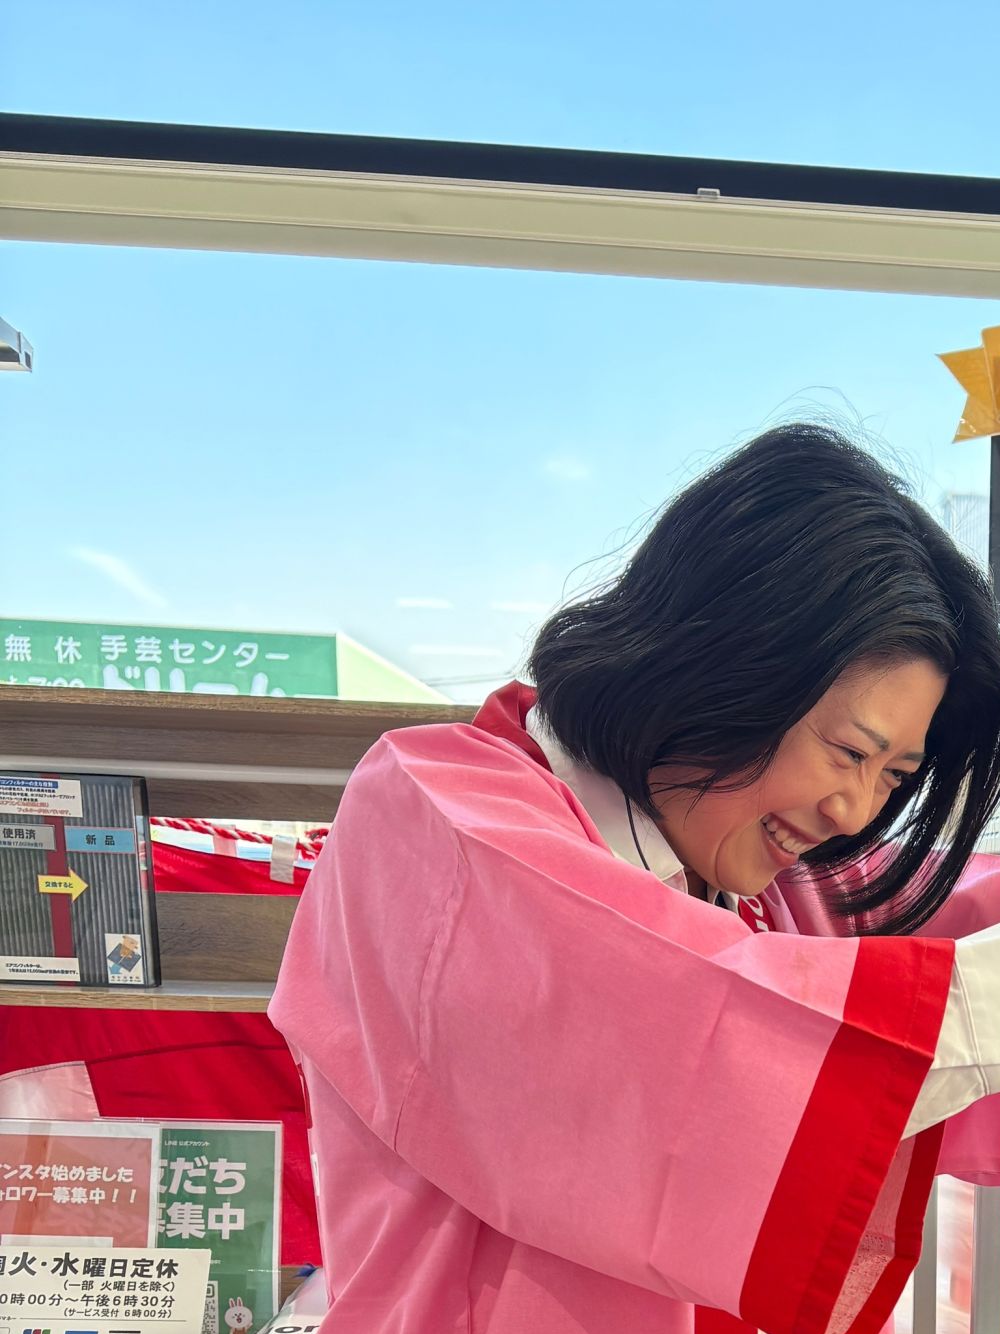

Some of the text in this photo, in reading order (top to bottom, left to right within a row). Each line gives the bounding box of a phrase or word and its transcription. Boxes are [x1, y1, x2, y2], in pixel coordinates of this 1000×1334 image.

[101, 634, 289, 668] 手芸センター
[3, 827, 36, 840] 使用済
[45, 881, 73, 889] 交換すると
[0, 1164, 134, 1183] ンスタ始めました
[158, 1201, 245, 1240] 集中
[0, 1251, 179, 1278] 火・水曜日定休
